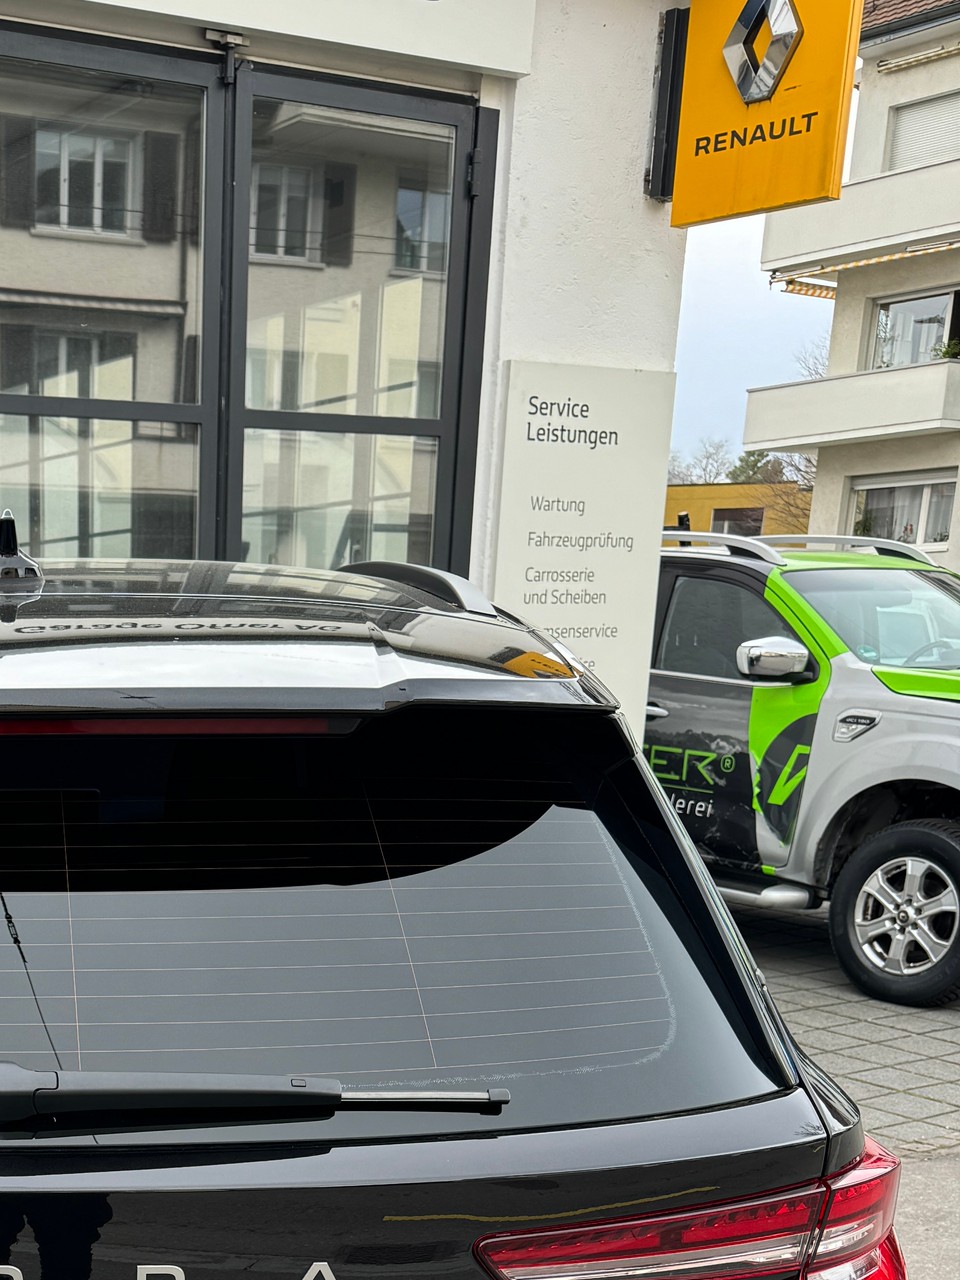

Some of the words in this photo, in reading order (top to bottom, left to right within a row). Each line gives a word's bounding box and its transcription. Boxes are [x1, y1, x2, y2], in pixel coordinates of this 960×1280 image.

[694, 111, 819, 157] RENAULT
[527, 395, 590, 419] Service
[526, 422, 619, 450] Leistungen
[530, 495, 585, 516] Wartung
[527, 531, 634, 552] Fahrzeugprüfung
[525, 567, 595, 583] Carrosserie
[523, 589, 547, 605] und
[550, 589, 607, 606] Scheiben
